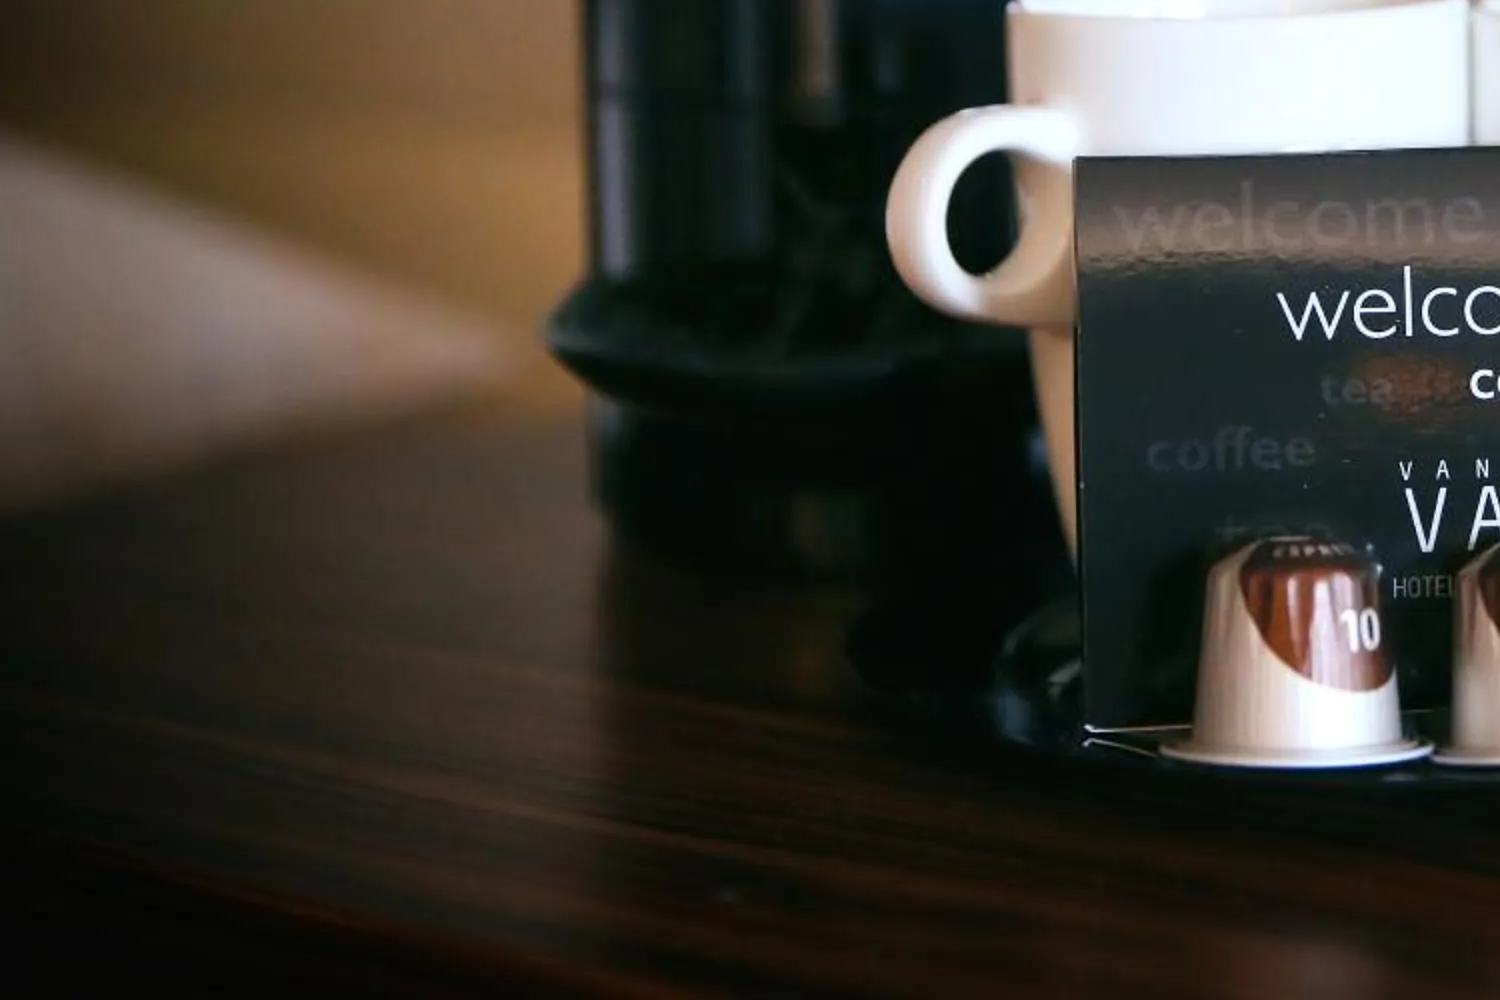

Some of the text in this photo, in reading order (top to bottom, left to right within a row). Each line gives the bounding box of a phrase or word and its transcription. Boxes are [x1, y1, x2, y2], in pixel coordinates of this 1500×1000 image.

[1112, 178, 1490, 251] welcome
[1320, 374, 1393, 411] tea
[1146, 425, 1317, 472] coffee
[1399, 457, 1490, 482] VAN
[1340, 608, 1381, 653] 10
